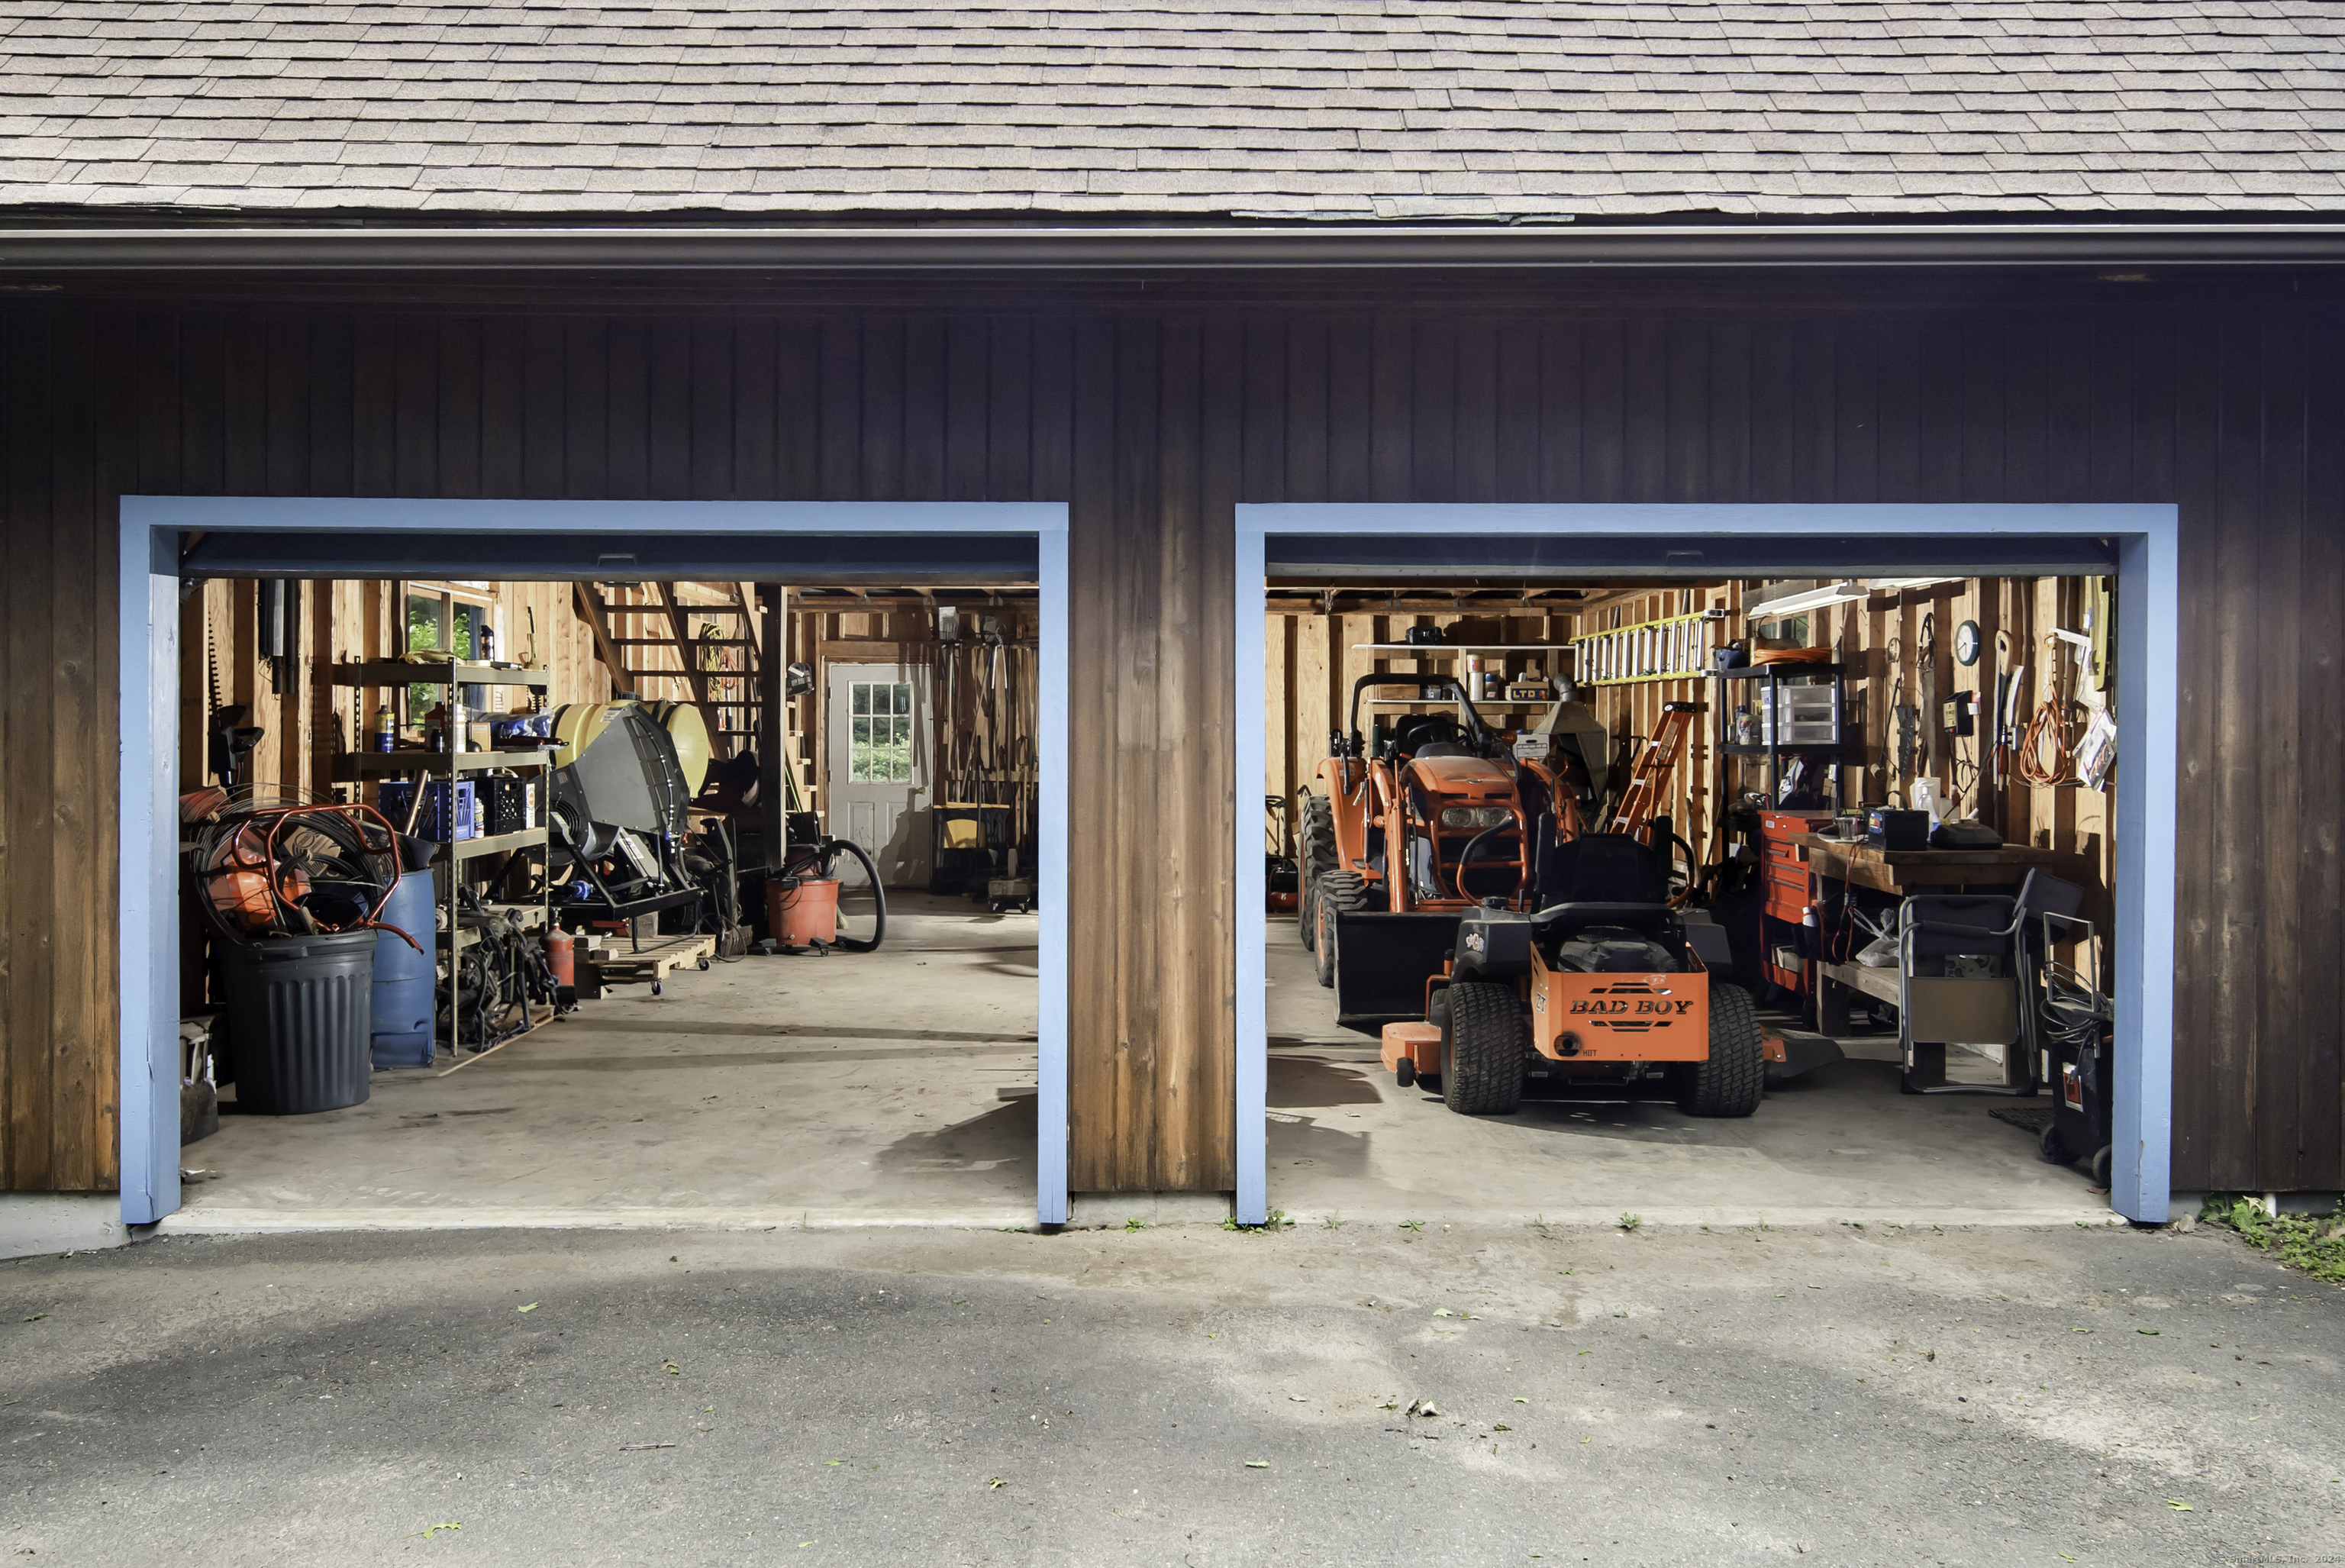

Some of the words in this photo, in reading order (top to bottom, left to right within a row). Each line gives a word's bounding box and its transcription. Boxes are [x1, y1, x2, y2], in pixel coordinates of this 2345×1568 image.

[1536, 992, 1547, 1014] ZT
[1569, 1000, 1628, 1015] BAD
[1635, 1000, 1693, 1015] BOY
